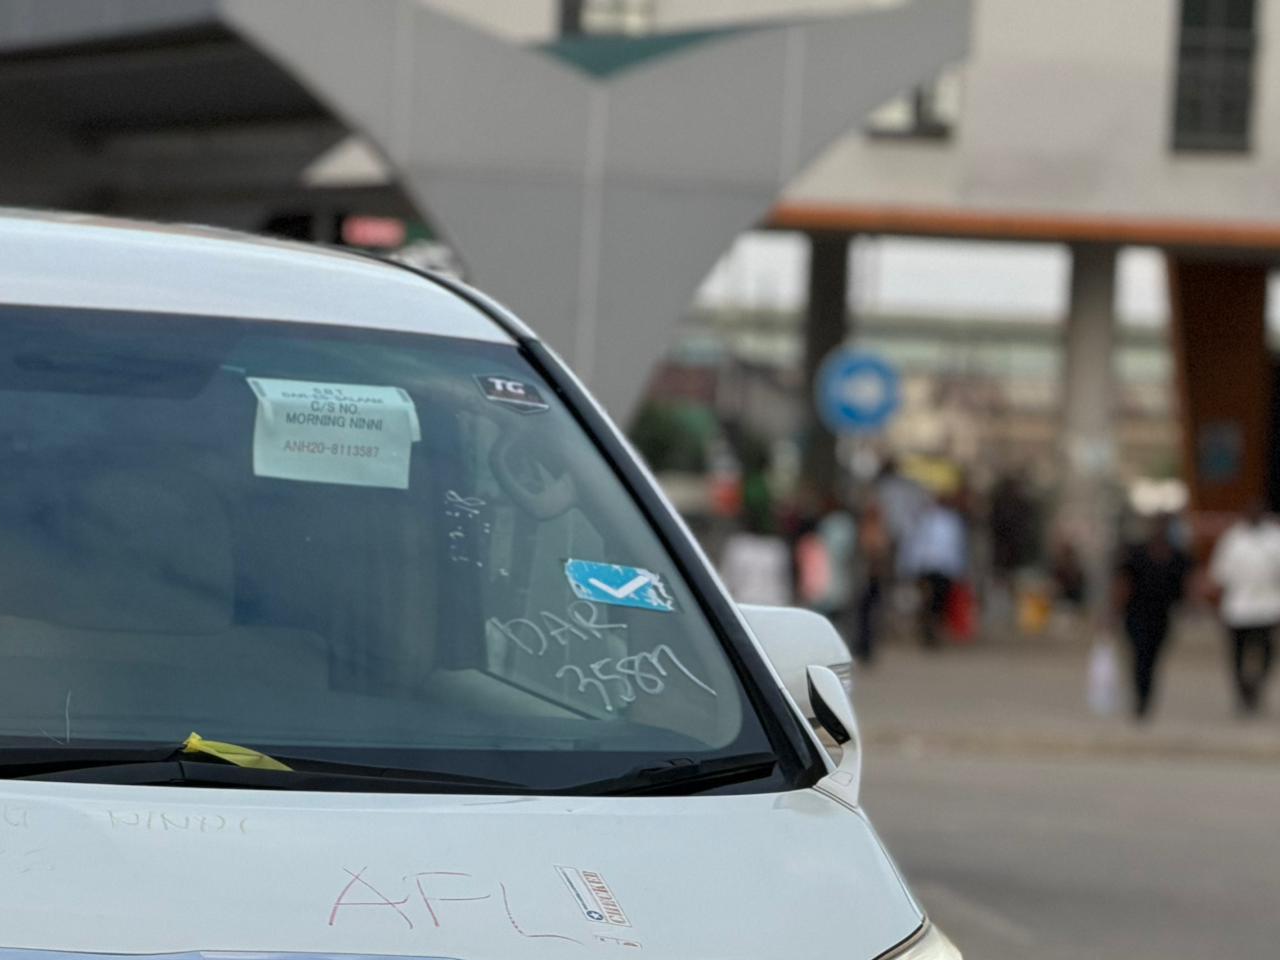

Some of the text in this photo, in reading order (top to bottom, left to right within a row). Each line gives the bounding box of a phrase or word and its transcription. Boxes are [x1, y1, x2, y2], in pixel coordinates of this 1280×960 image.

[285, 412, 384, 431] MORNING NINNI
[486, 600, 629, 656] DAR
